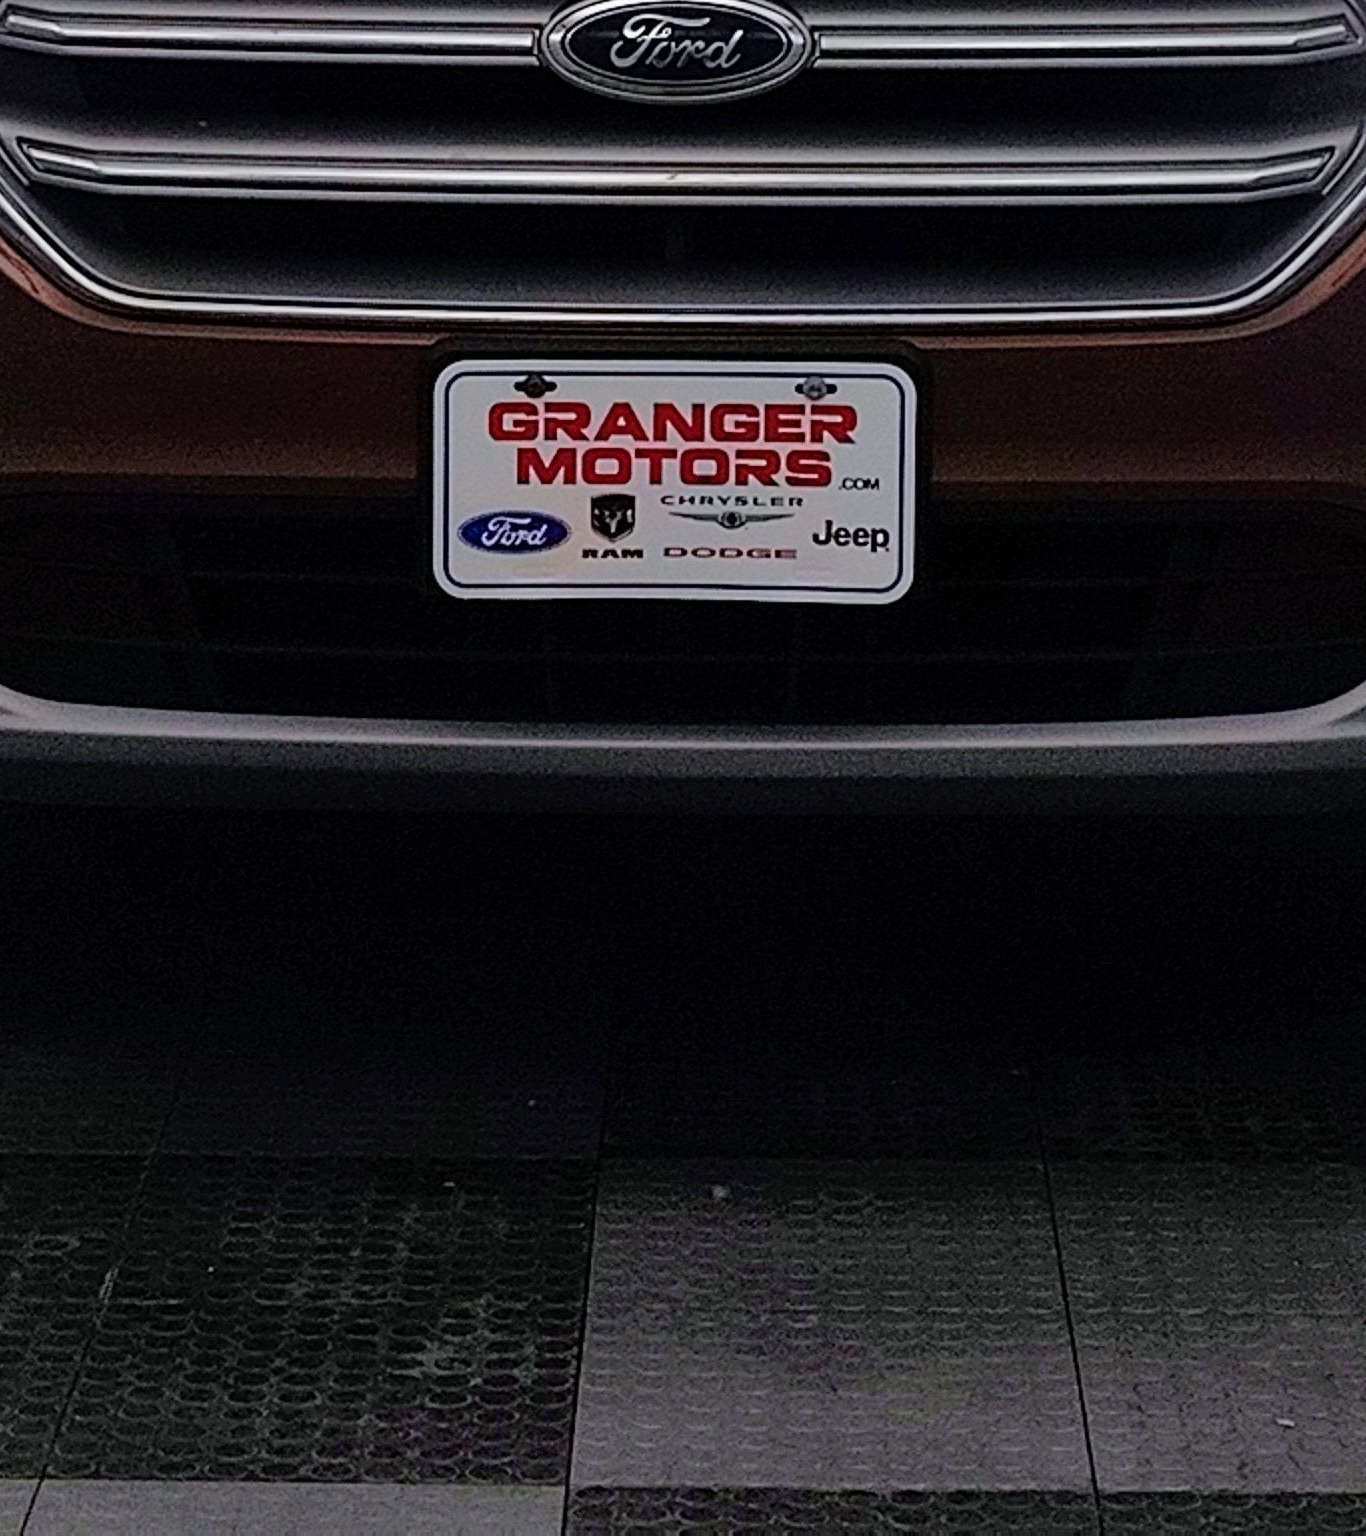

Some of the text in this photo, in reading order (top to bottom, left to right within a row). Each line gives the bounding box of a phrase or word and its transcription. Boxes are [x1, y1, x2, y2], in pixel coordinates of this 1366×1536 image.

[610, 14, 744, 68] Ford
[488, 401, 858, 444] GRANGER
[516, 447, 833, 488] MOTORS
[660, 495, 804, 507] CHRYSLER
[481, 516, 548, 547] Ford
[812, 520, 890, 552] Jeep
[582, 549, 644, 559] RAM
[663, 547, 798, 559] DODGE
